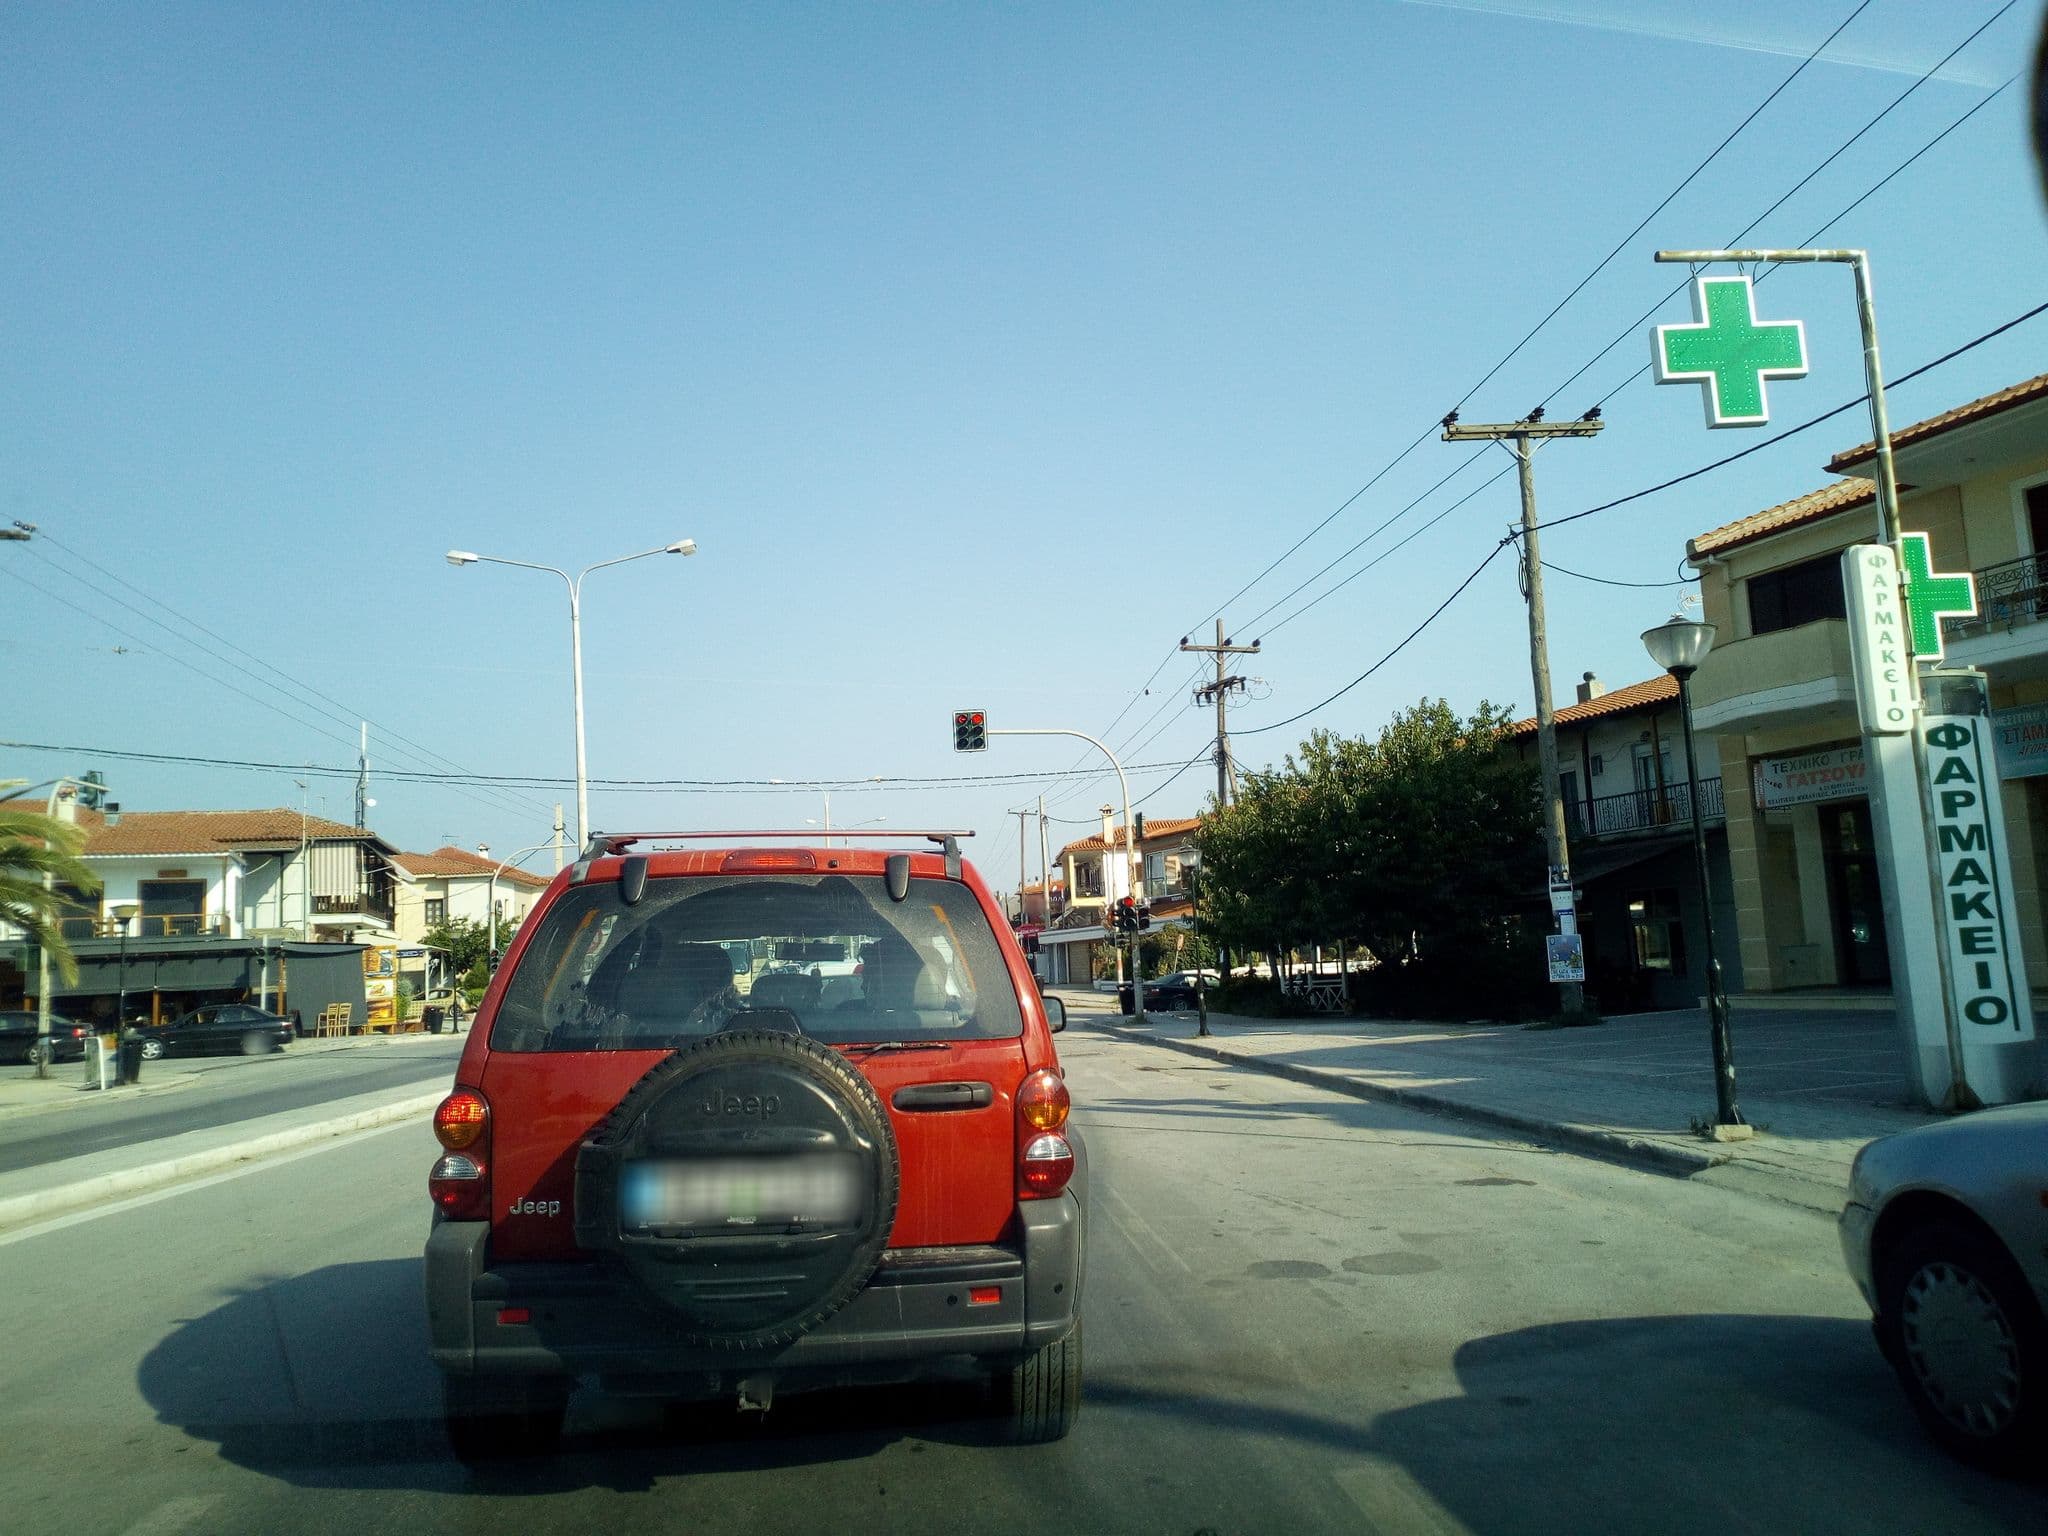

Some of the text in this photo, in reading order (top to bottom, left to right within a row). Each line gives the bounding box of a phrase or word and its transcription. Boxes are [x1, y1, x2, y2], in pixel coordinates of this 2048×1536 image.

[1868, 555, 1904, 722] ΦΑΡΜΑΚΕΙΟ
[1926, 723, 2008, 1026] ΦΑΡΜΑΚΕΙΟ
[700, 1088, 782, 1121] Jeep
[509, 1196, 561, 1218] Jeep
